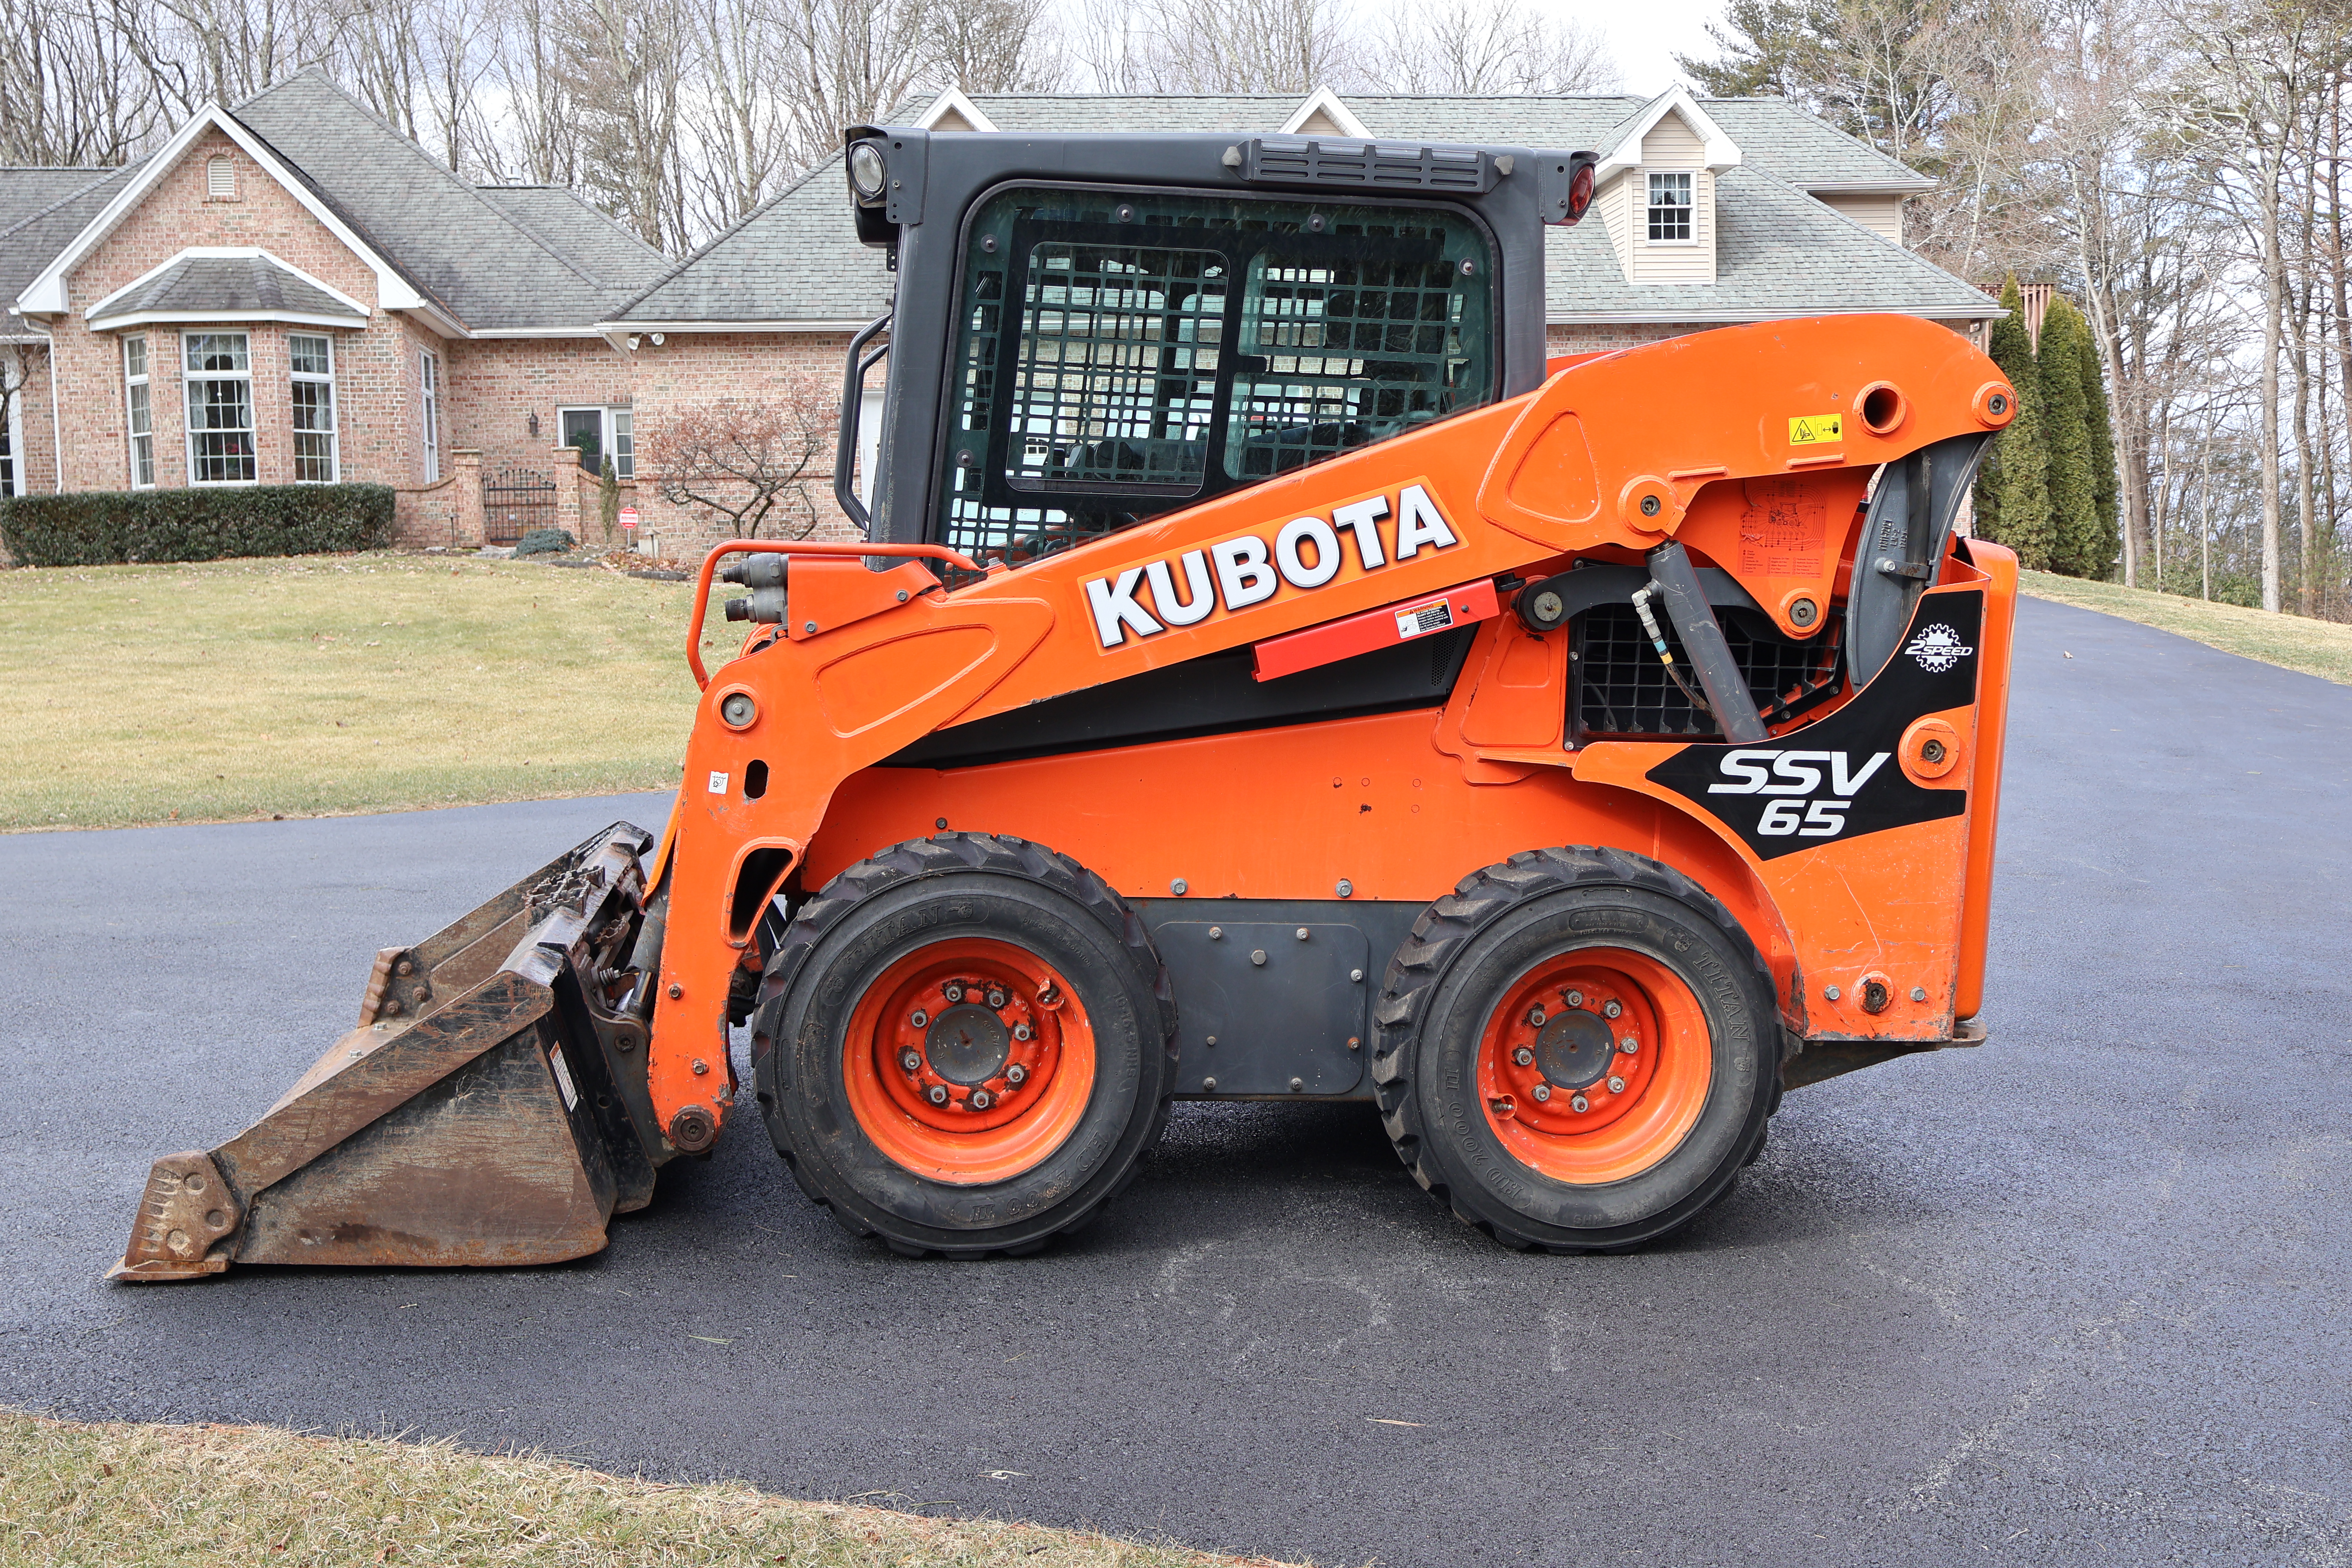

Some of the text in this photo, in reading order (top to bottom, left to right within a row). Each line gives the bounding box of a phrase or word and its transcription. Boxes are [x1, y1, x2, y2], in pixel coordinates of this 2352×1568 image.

[1086, 484, 1457, 647] KUBOTA
[1708, 750, 1891, 796] SSV
[1757, 800, 1851, 836] 65
[846, 904, 941, 972] TITAN
[1023, 917, 1093, 968] DIRECTION OF ROTATION
[1693, 951, 1750, 1044] TITAN
[1126, 1047, 1138, 1078] NHS
